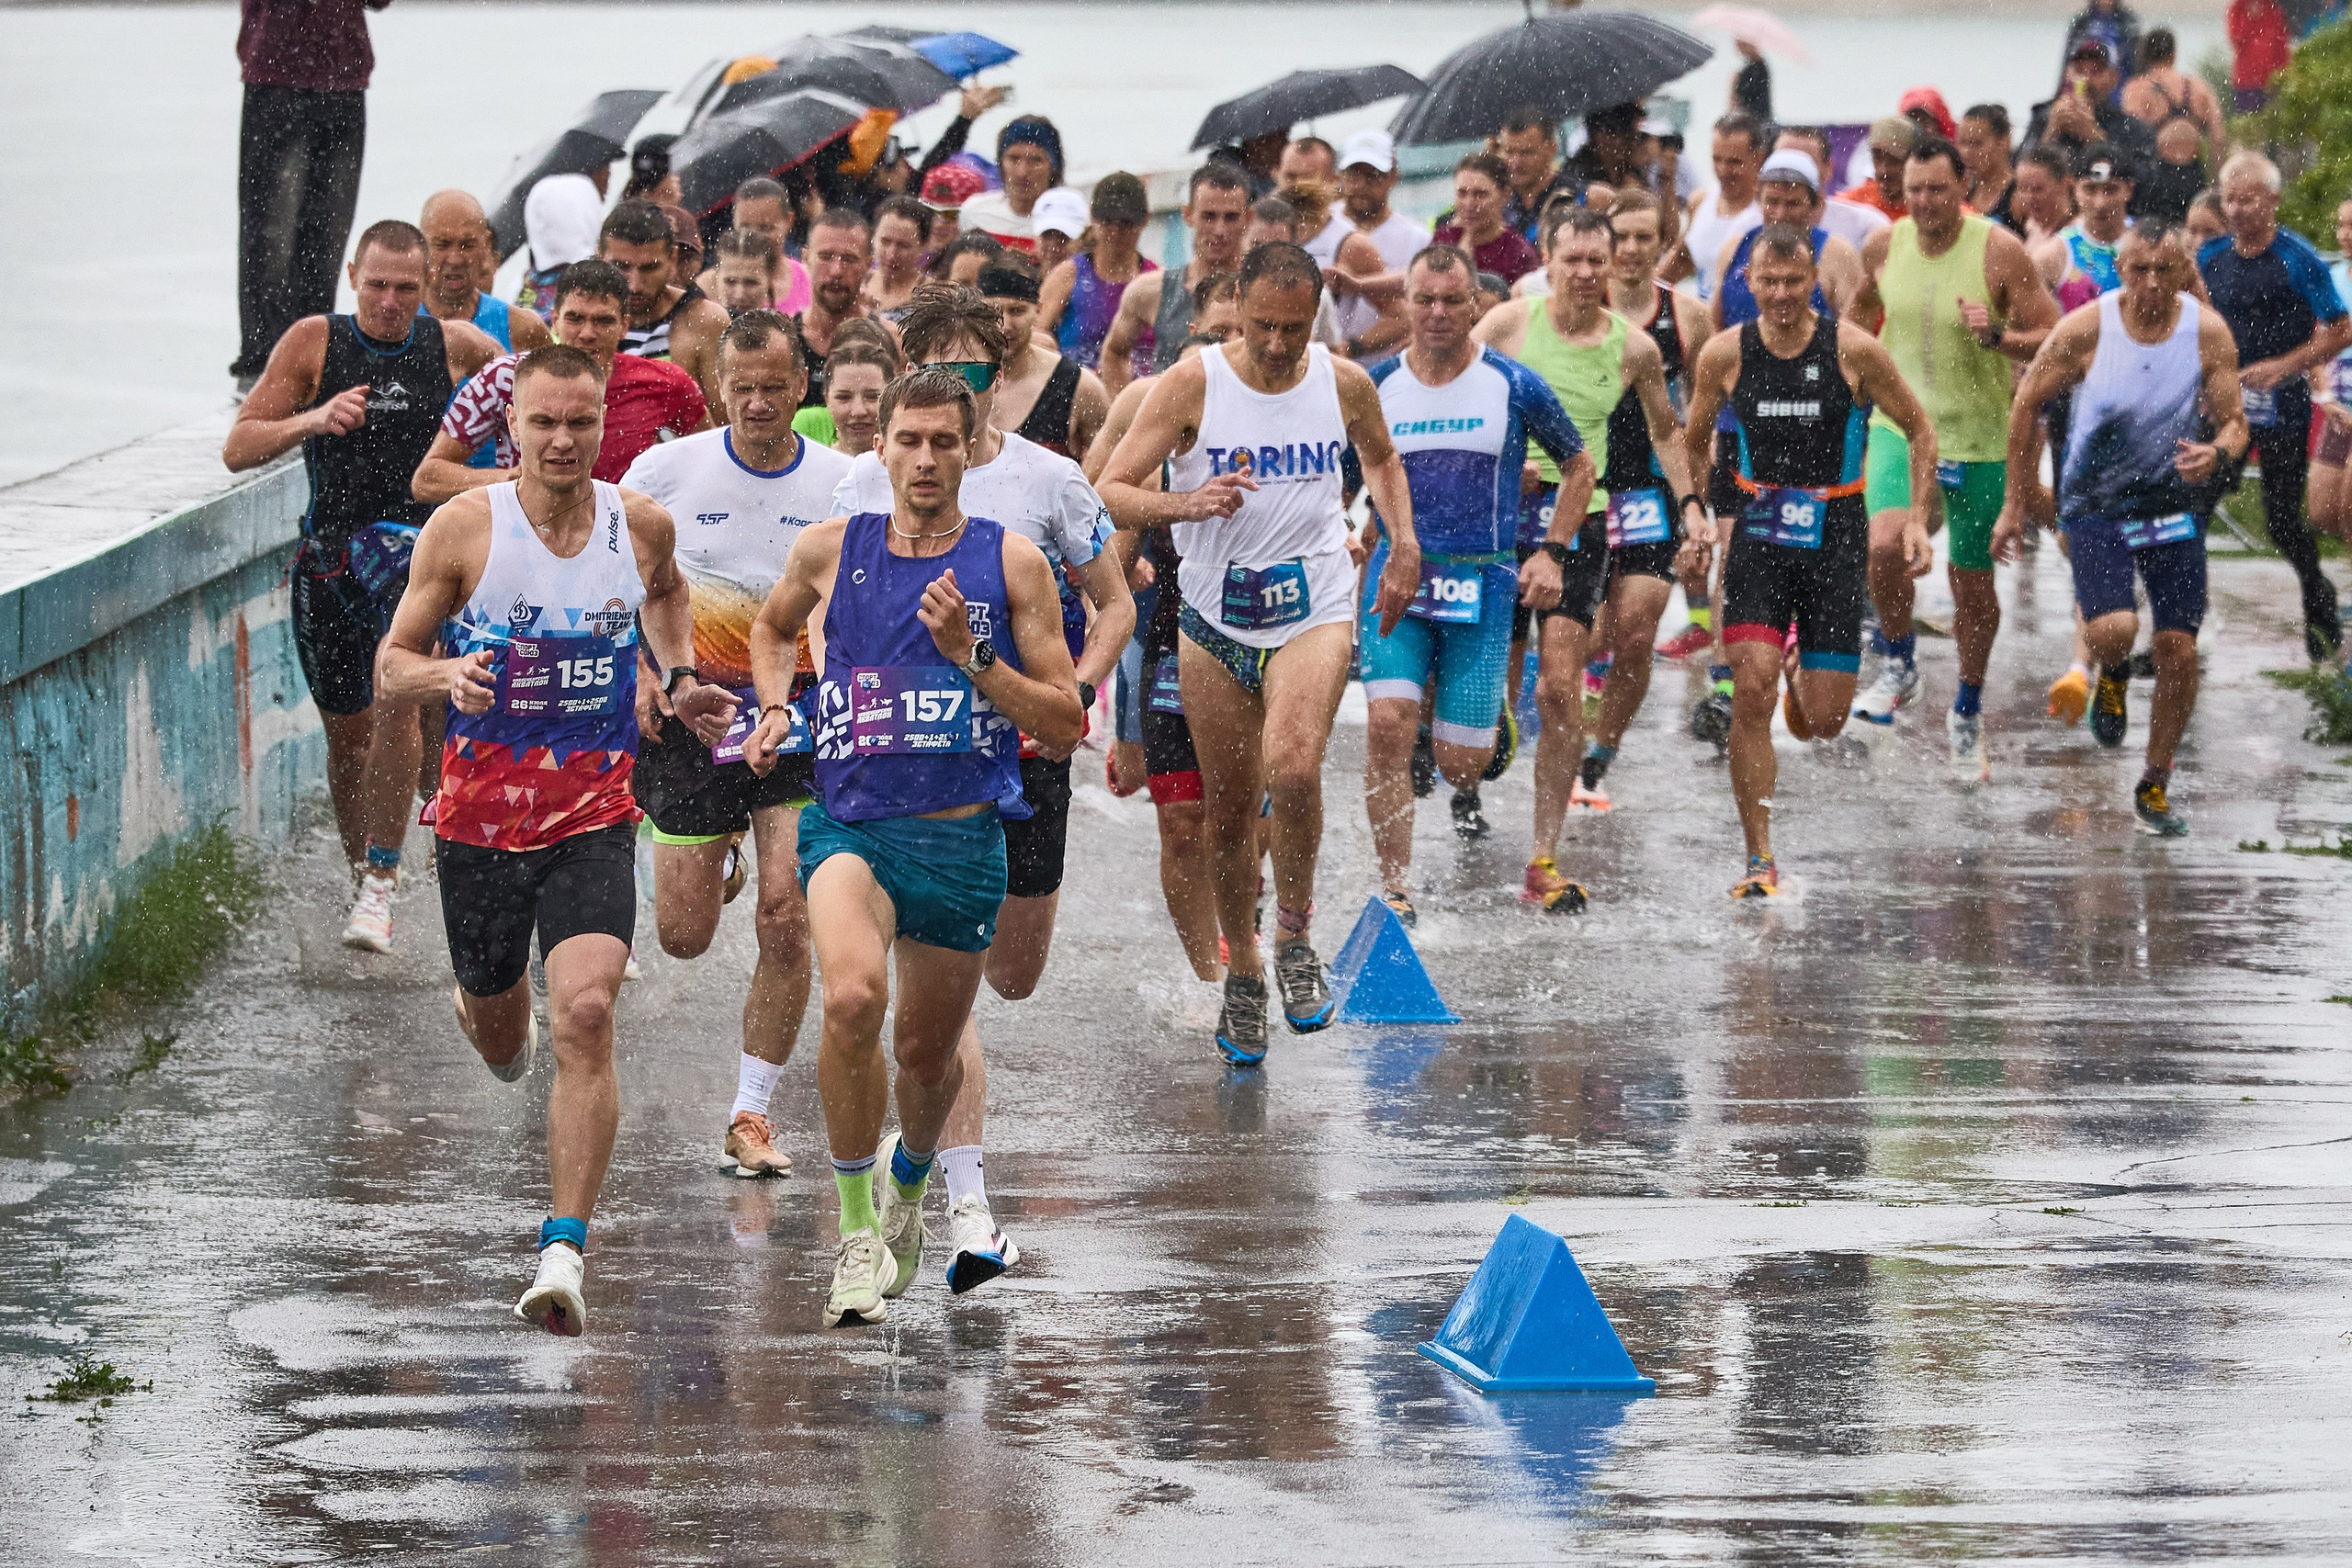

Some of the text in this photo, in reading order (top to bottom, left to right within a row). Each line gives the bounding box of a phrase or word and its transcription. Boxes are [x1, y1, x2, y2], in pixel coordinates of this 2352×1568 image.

[1393, 418, 1484, 436] СИБУР
[1538, 506, 1555, 529] 9
[1620, 501, 1662, 530] 22
[1781, 502, 1815, 528] 96
[608, 511, 619, 554] pulse.
[1261, 577, 1301, 608] 113
[1430, 577, 1479, 603] 108
[584, 611, 632, 622] DMITRIENKO
[511, 679, 549, 688] АКВАТЛОН
[557, 655, 615, 689] 155
[511, 699, 528, 709] 26
[747, 705, 804, 728] 14
[900, 691, 965, 722] 157
